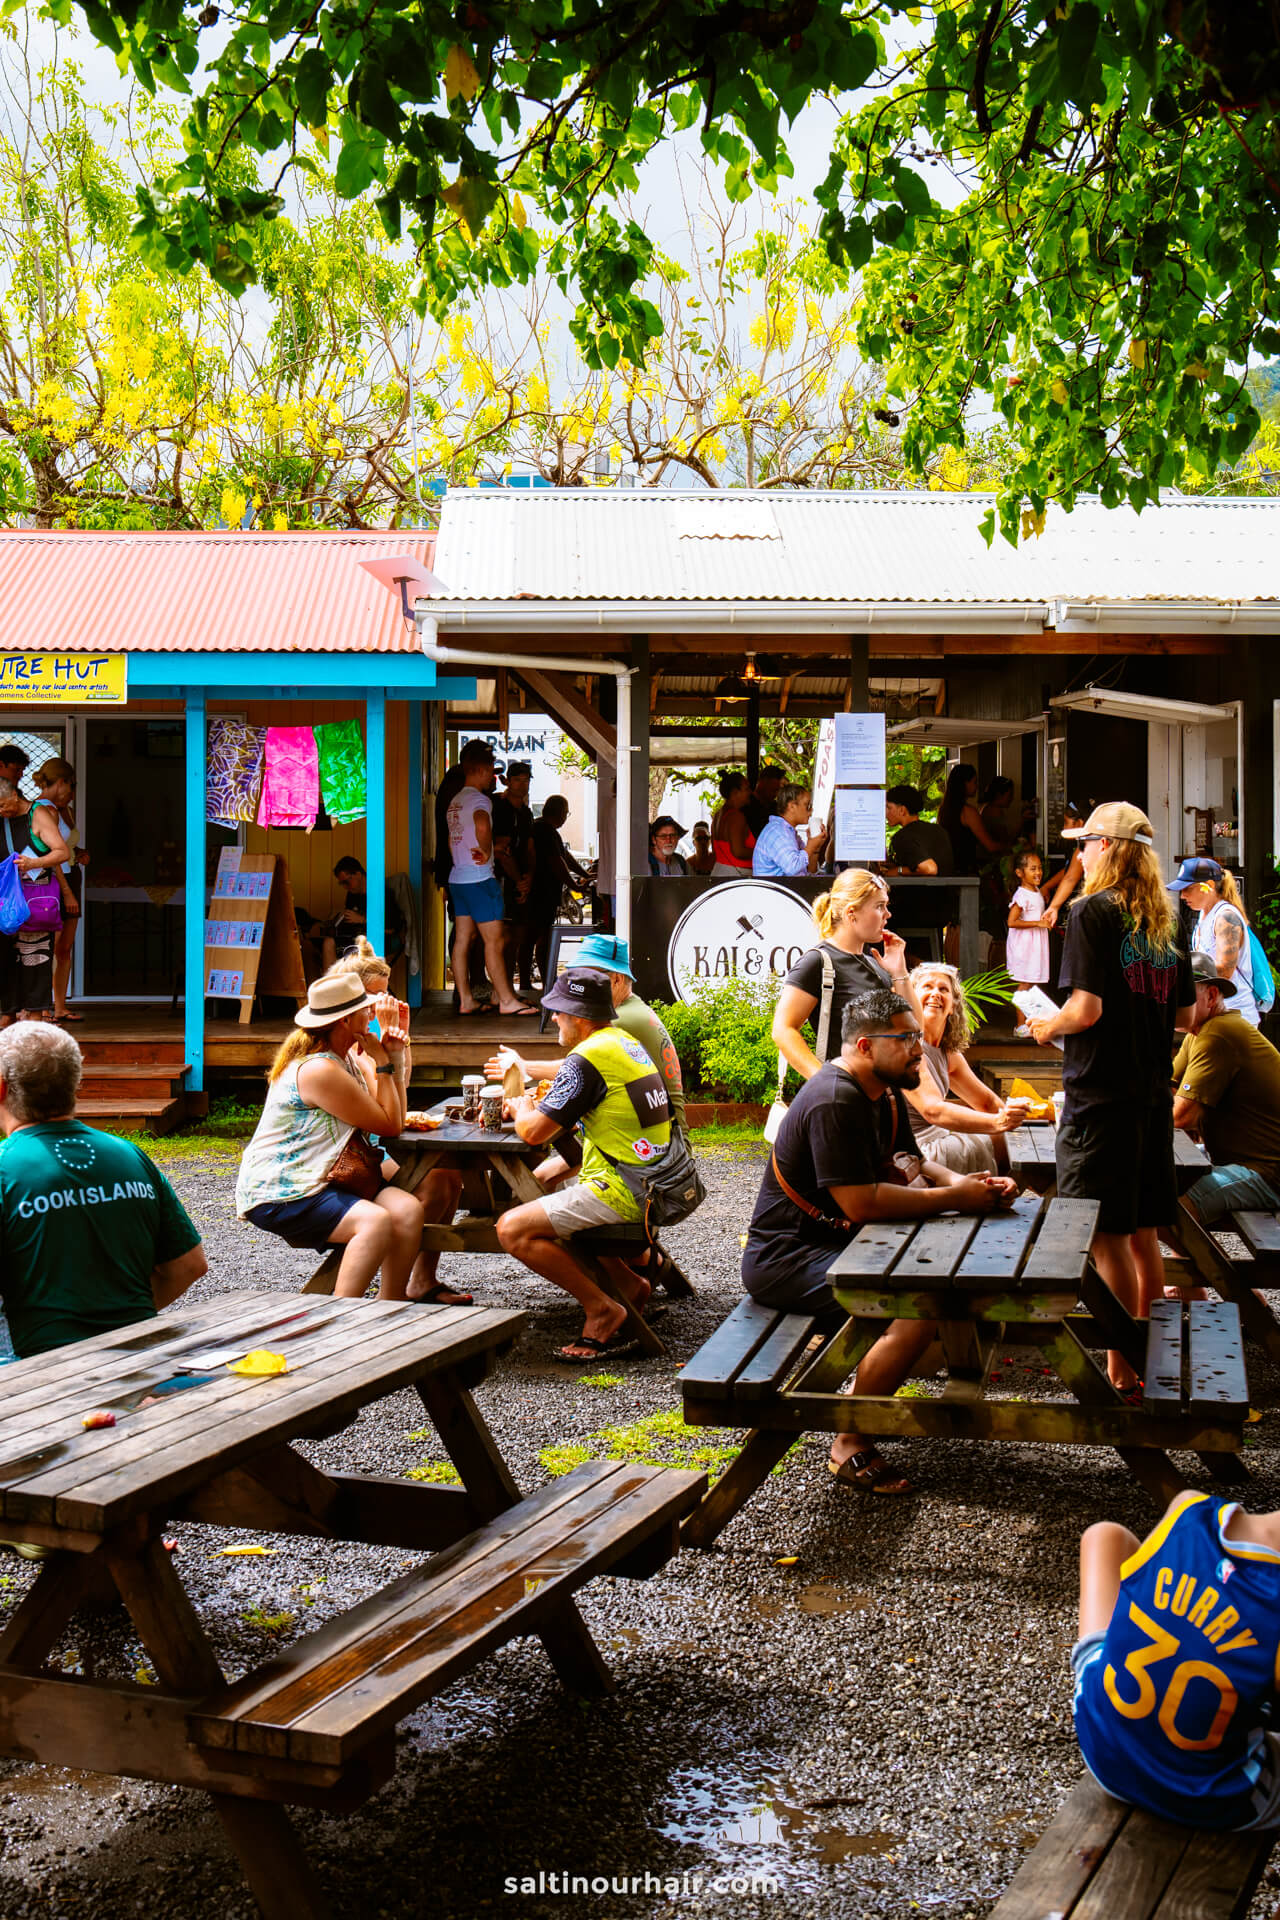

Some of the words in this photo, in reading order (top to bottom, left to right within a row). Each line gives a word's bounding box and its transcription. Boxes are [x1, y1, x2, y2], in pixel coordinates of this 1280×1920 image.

[54, 658, 109, 680] HUT
[32, 683, 40, 692] by
[693, 945, 739, 978] KAI
[744, 947, 764, 976] &
[18, 1188, 78, 1219] COOK
[78, 1181, 156, 1205] ISLANDS
[1153, 1566, 1258, 1655] CURRY
[1103, 1601, 1239, 1751] 30
